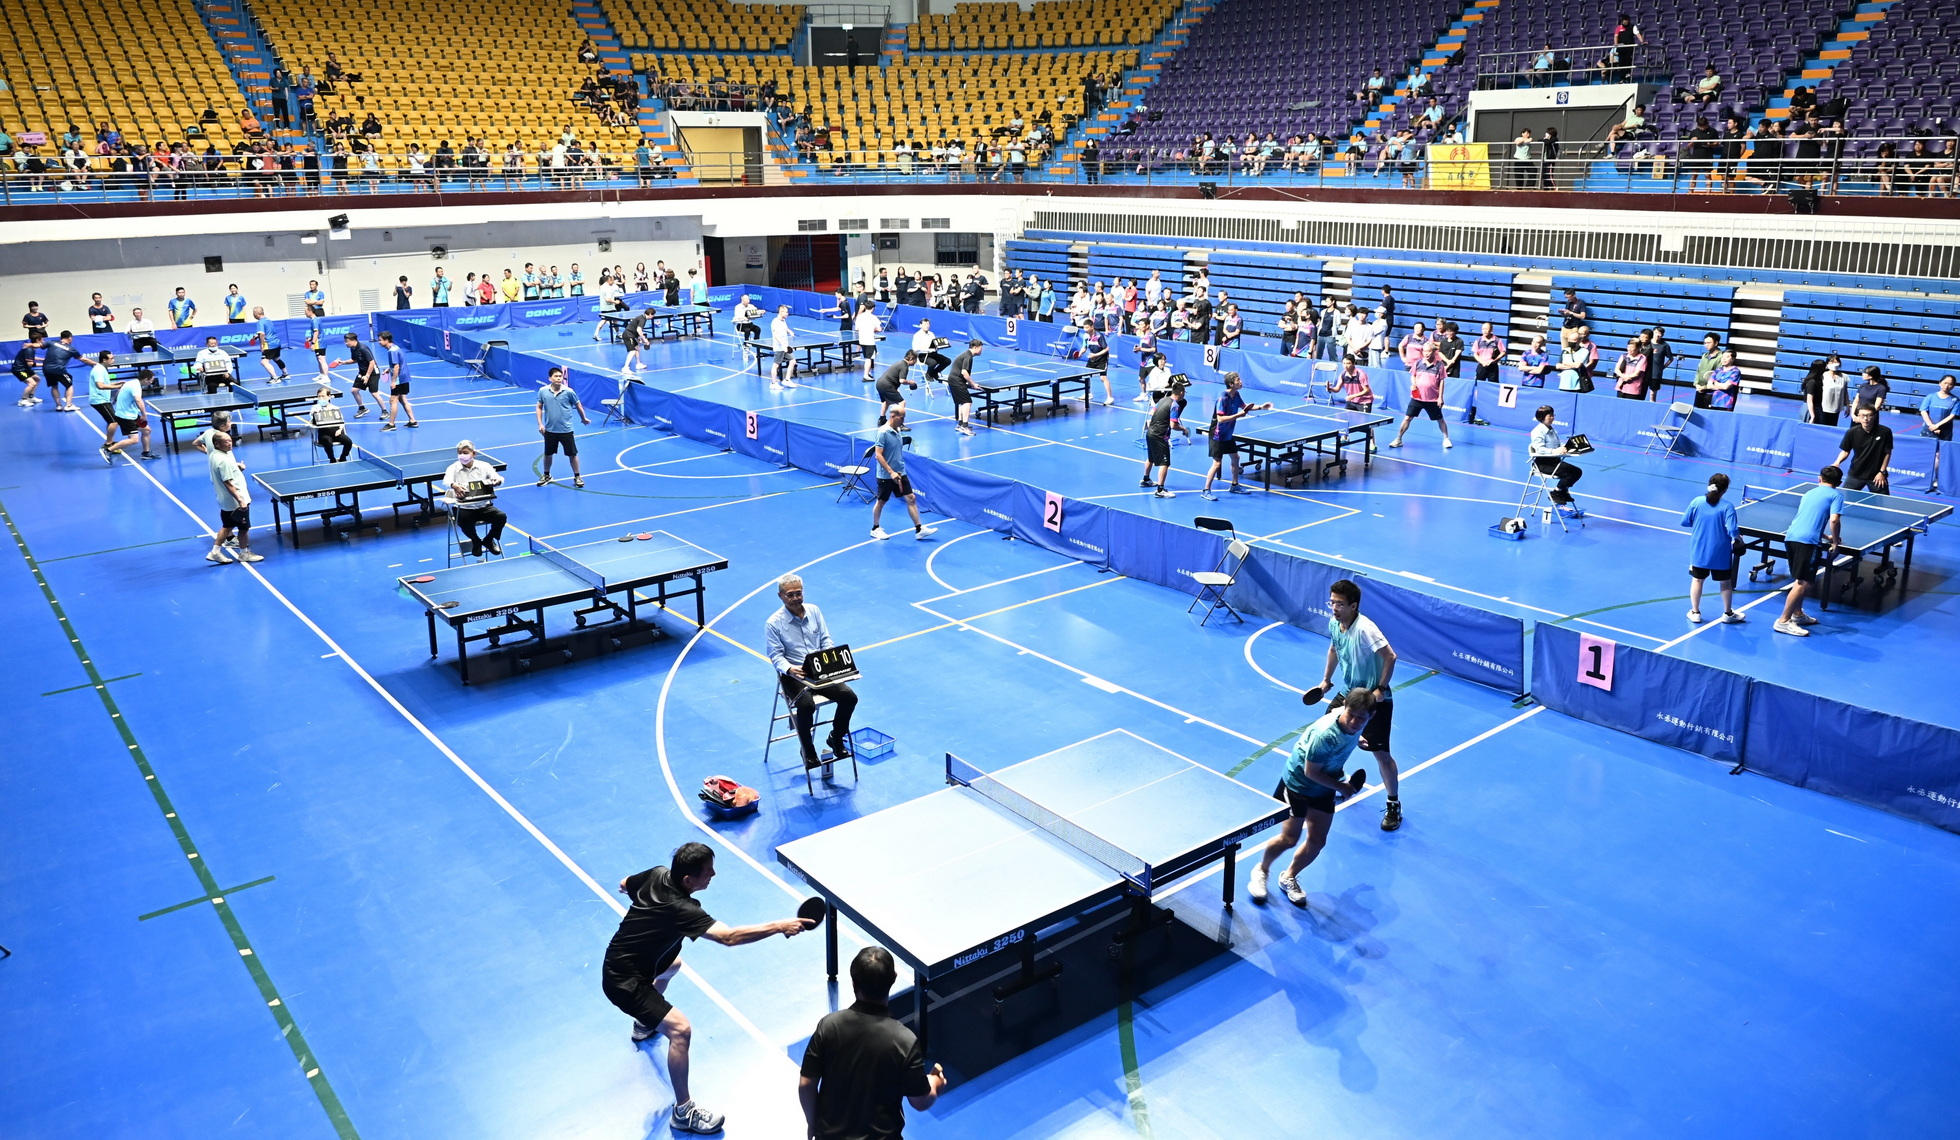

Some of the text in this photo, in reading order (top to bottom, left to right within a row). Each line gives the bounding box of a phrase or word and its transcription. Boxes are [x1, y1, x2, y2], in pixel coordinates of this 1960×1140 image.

[525, 307, 563, 318] DONIC
[455, 315, 496, 325] DONIC
[1008, 320, 1015, 333] 9
[305, 326, 351, 337] DNIC
[1206, 348, 1214, 363] 8
[1503, 386, 1514, 403] 7
[748, 415, 756, 435] 3
[316, 490, 336, 498] 3250
[1047, 500, 1059, 526] 2
[1543, 510, 1552, 521] T
[696, 565, 716, 575] 3250
[495, 606, 520, 617] 3250
[813, 656, 822, 673] 6
[822, 652, 829, 664] 0
[839, 648, 852, 666] 10
[1585, 645, 1607, 681] 1
[1251, 817, 1276, 834] 3250
[993, 929, 1026, 951] 3250
